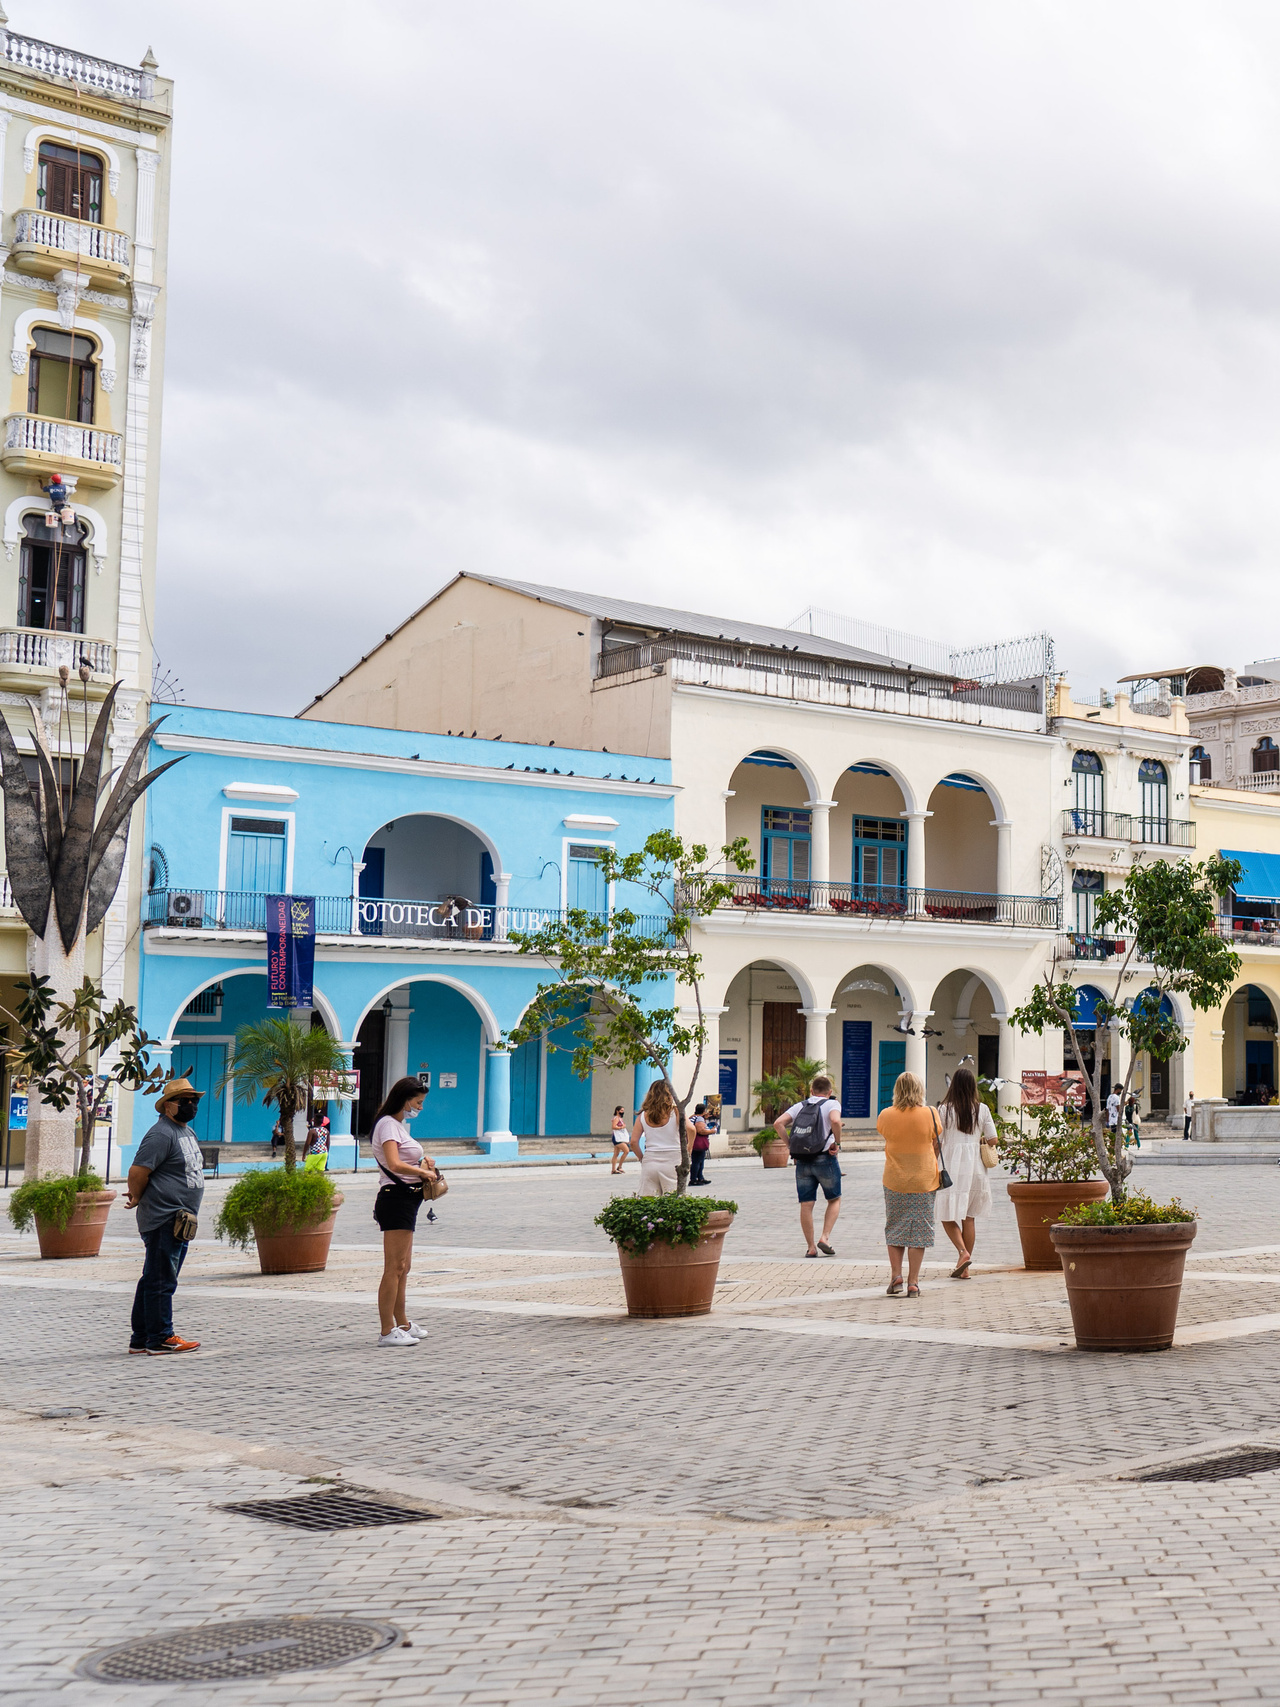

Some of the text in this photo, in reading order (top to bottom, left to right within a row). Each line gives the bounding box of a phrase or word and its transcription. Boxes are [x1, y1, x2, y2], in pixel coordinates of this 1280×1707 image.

[358, 902, 550, 932] FOTOTECA DE CUBA
[278, 901, 286, 990] CONTEMPORANEIDAD
[271, 956, 279, 990] FUTURO
